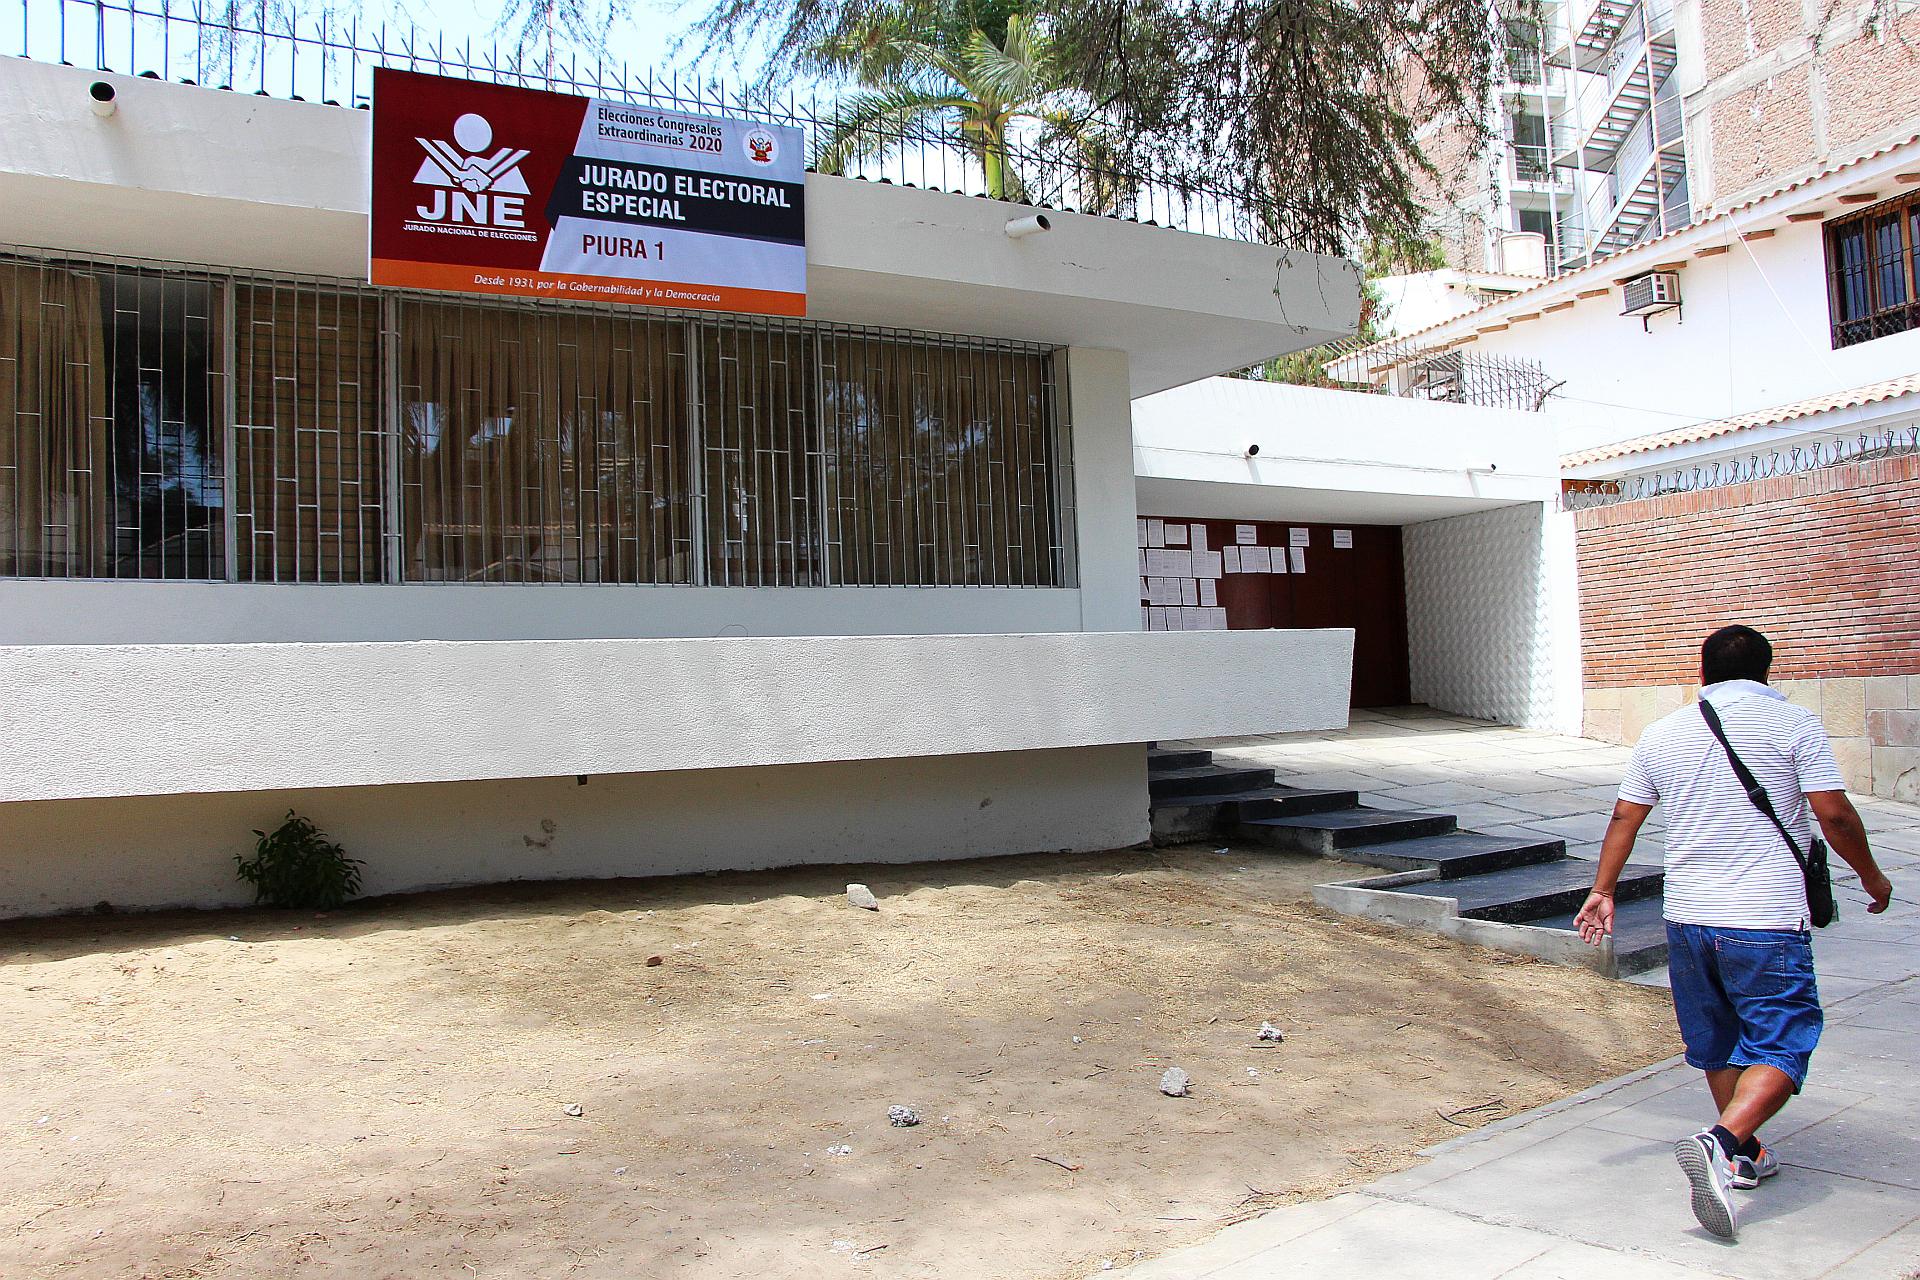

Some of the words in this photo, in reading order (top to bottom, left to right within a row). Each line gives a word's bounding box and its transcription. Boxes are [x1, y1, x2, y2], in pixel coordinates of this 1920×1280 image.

[598, 107, 655, 127] Elecciones
[657, 116, 722, 136] Congresales
[598, 123, 684, 146] Extraordinarias
[689, 134, 723, 152] 2020
[578, 164, 668, 193] JURADO
[674, 175, 791, 208] ELECTORAL
[416, 189, 525, 228] JNE
[582, 190, 686, 221] ESPECIAL
[403, 224, 436, 233] JURADO
[437, 227, 477, 237] NACIONAL
[478, 230, 489, 238] DE
[490, 231, 538, 242] ELECCIONES
[582, 234, 648, 259] PIURA
[654, 241, 664, 260] 1
[474, 274, 505, 286] Desde
[537, 280, 555, 291] por
[556, 280, 567, 290] la
[569, 281, 643, 297] Gobernabilidad
[645, 289, 652, 298] y
[653, 287, 663, 298] la
[665, 289, 721, 302] Democracia
